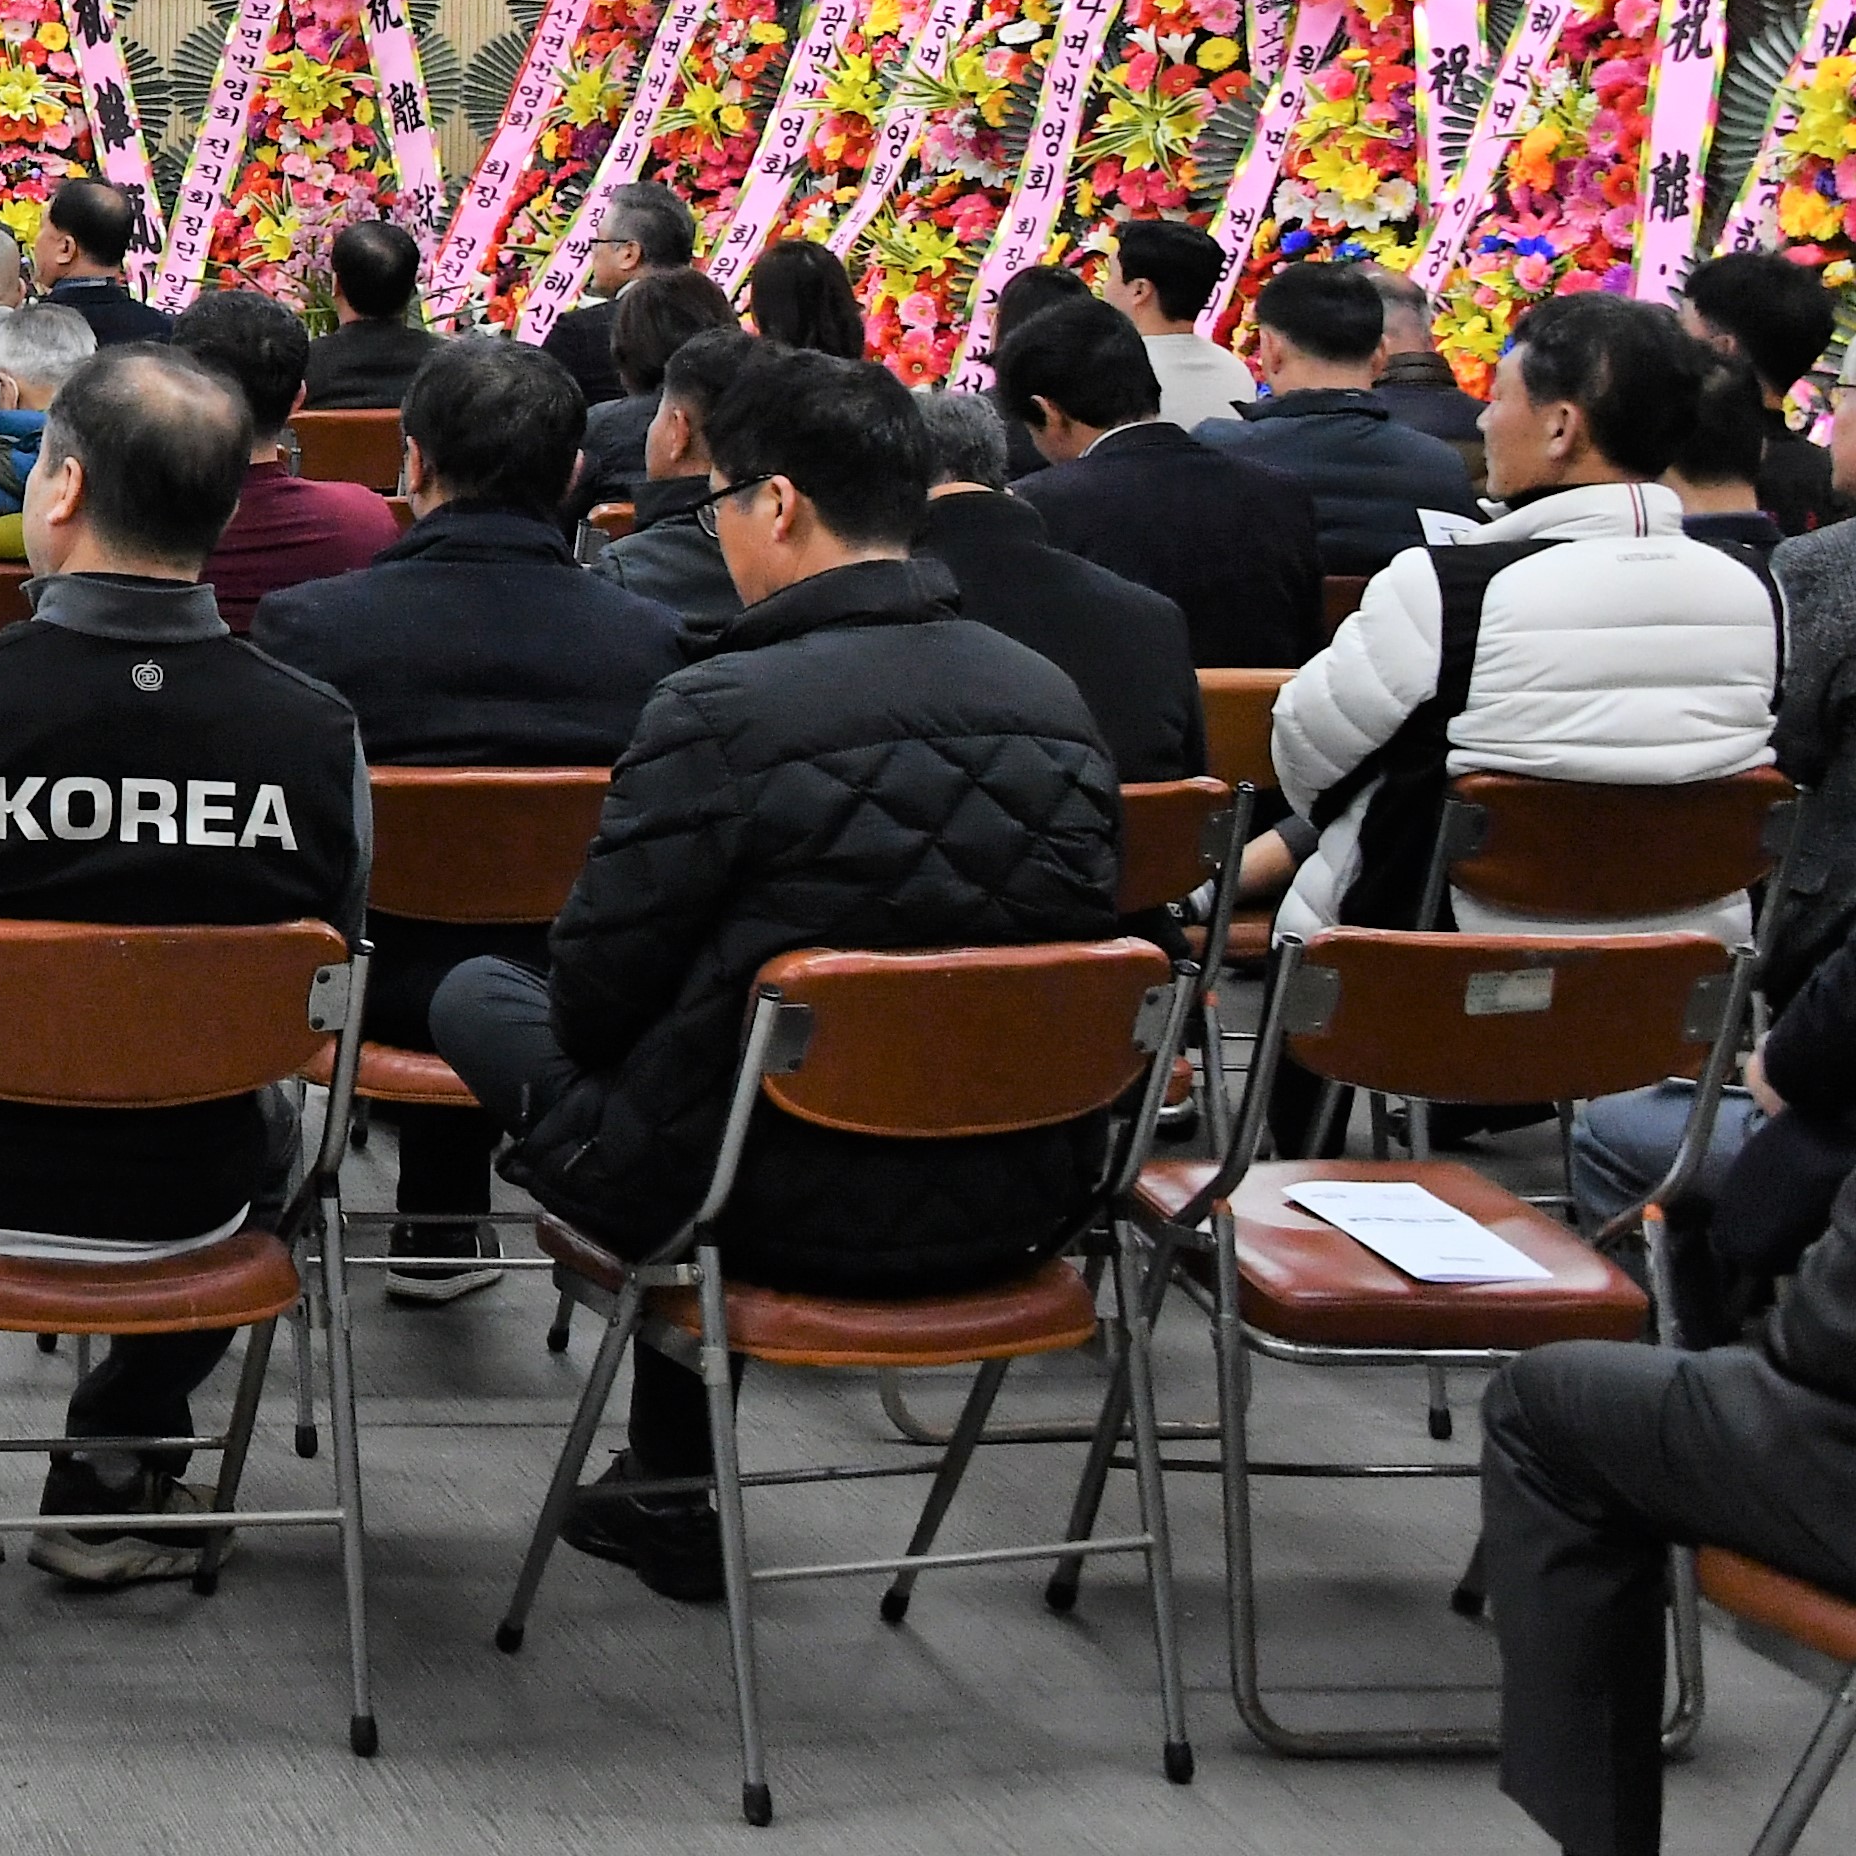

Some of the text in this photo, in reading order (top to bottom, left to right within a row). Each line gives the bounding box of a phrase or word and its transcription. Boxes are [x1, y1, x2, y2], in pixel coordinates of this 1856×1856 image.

[175, 136, 230, 263] 전직회장단
[473, 158, 511, 209] 회장
[1002, 216, 1037, 271] 회장
